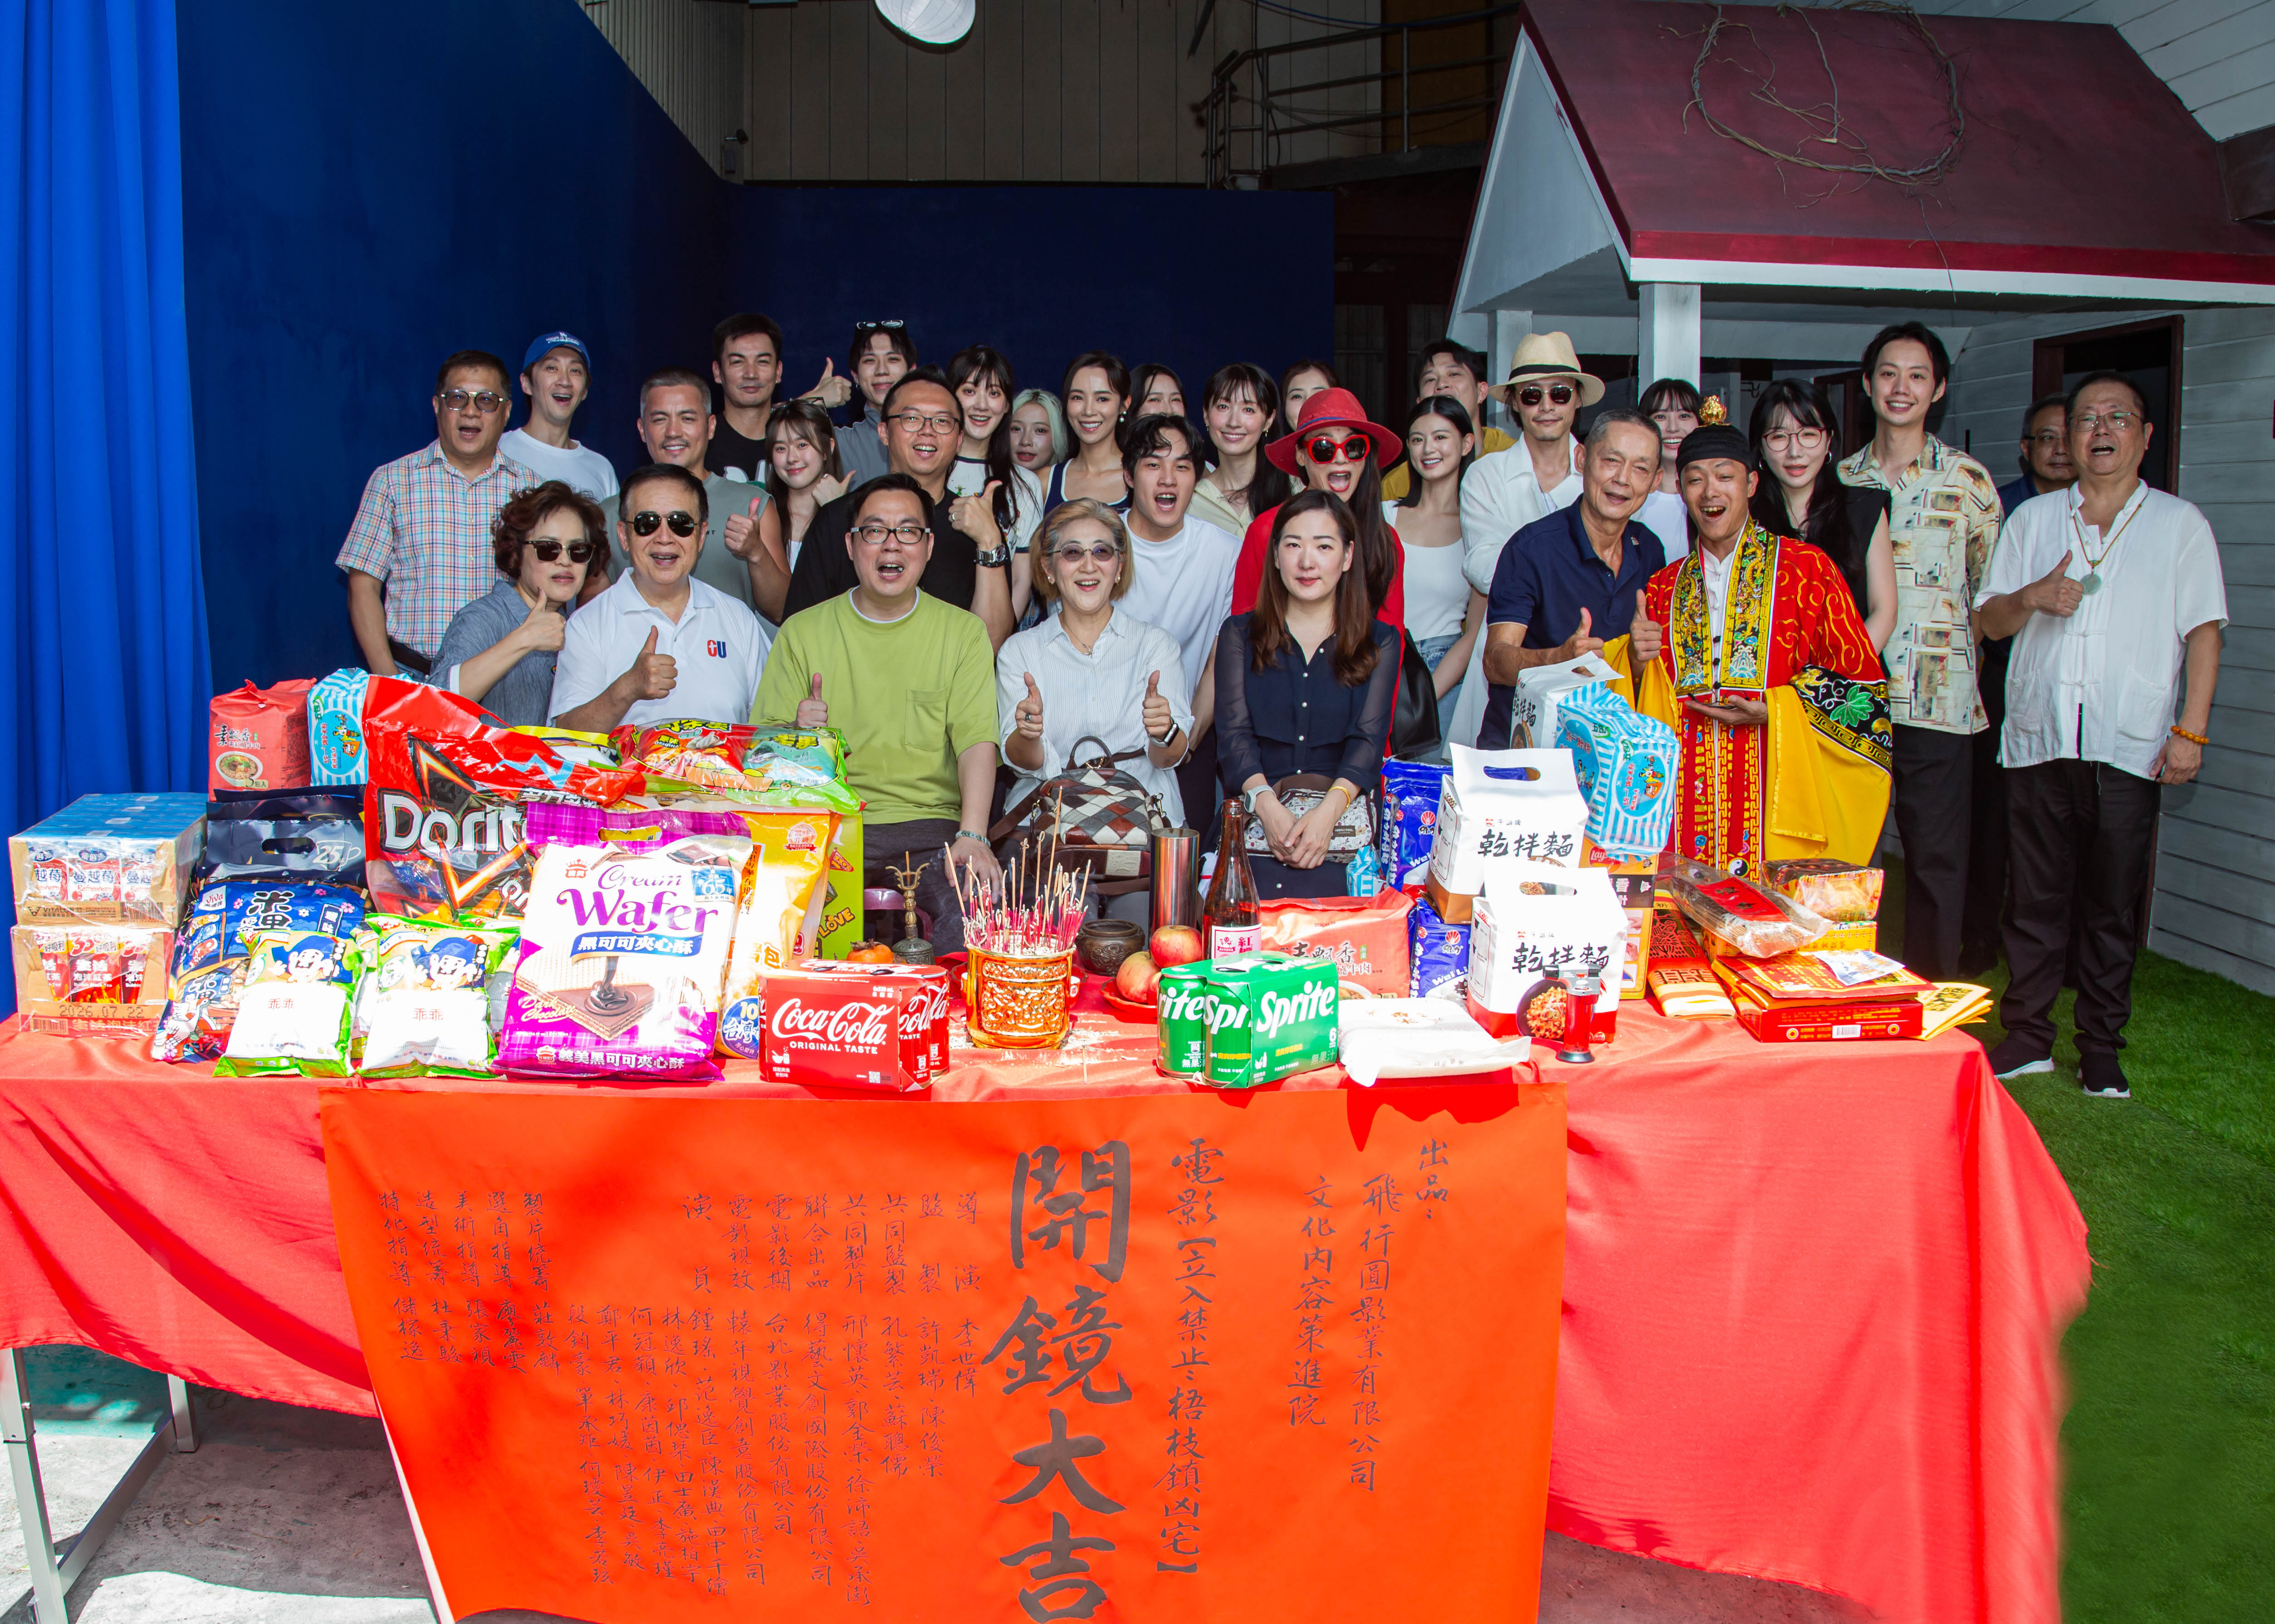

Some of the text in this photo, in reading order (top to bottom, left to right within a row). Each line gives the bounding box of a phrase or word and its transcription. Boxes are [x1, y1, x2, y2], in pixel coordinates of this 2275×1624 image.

[384, 793, 527, 854] Dorit
[1478, 829, 1574, 857] 乾拌麵
[73, 870, 113, 883] 蔓越莓
[313, 845, 344, 864] 25
[598, 864, 682, 889] Cream
[557, 888, 719, 933] Wafer
[817, 907, 856, 939] LOVE
[577, 935, 694, 955] 黑可可夾心酥
[521, 995, 559, 1009] Dark
[1432, 970, 1455, 986] Wei
[521, 1005, 578, 1024] Chocolate
[772, 998, 895, 1045] Coca-Cola
[1256, 980, 1336, 1039] Sprite
[1329, 1027, 1337, 1043] 6
[558, 1049, 685, 1069] 義美黑可可夾心酥
[789, 1041, 878, 1054] ORIGINAL TASTE
[1311, 1049, 1335, 1066] 無果汁
[378, 1190, 416, 1287] 特化指導
[416, 1190, 448, 1285] 造型統籌
[454, 1190, 484, 1287] 美術指導
[682, 1193, 712, 1294] 演員
[721, 1195, 755, 1291] 電影視效
[763, 1194, 793, 1292] 電影後期
[802, 1193, 833, 1288] 聯合出品
[840, 1193, 867, 1294] 共同製片
[881, 1193, 908, 1295] 共同監製
[919, 1193, 944, 1293] 監製
[486, 1191, 527, 1374] 選角指導 廖麗雯
[523, 1192, 560, 1376] 製片統籌 莊敦麟
[951, 1192, 983, 1399] 導演 李世偉
[1349, 1174, 1403, 1492] 飛行圓影業有限公司
[980, 1139, 1133, 1624] 開鏡大吉
